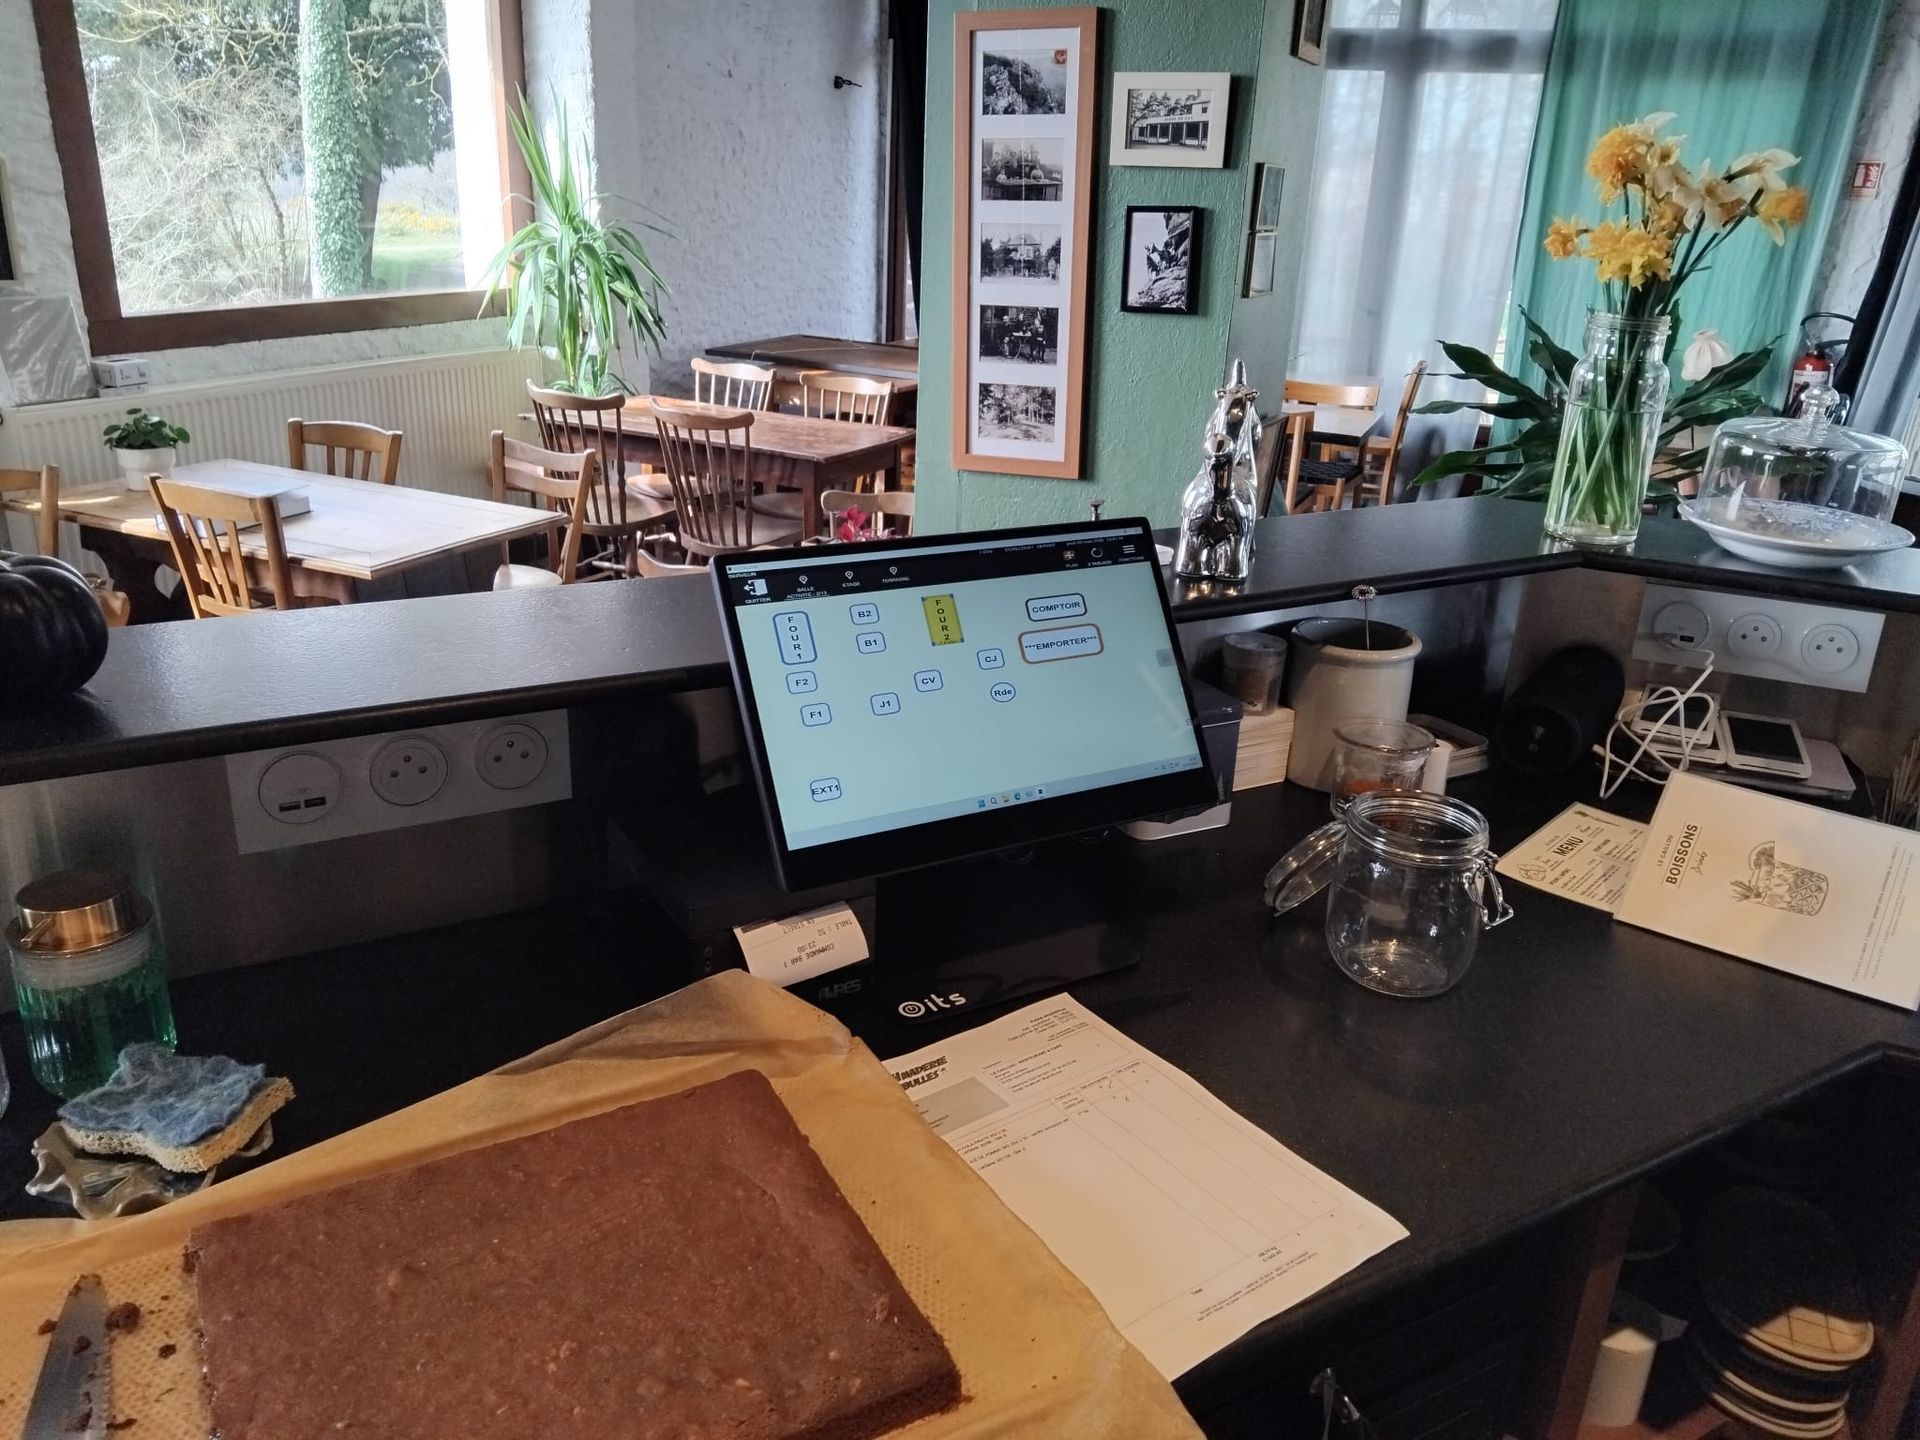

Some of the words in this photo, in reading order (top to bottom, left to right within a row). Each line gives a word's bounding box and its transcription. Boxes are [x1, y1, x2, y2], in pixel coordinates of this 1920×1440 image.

[745, 597, 772, 605] QUITTER
[1032, 600, 1081, 613] COMPTOIR
[857, 610, 872, 619] B2
[864, 638, 878, 647] B1
[984, 655, 997, 664] CJ
[795, 678, 809, 687] F2
[921, 676, 936, 685] CV
[993, 688, 1013, 697] Rde
[879, 700, 891, 709] J1
[809, 710, 822, 719] F1
[811, 784, 839, 796] EXT1
[1552, 836, 1584, 857] MENU
[1666, 823, 1698, 885] BOISSONS
[805, 942, 835, 960] COMMANDE
